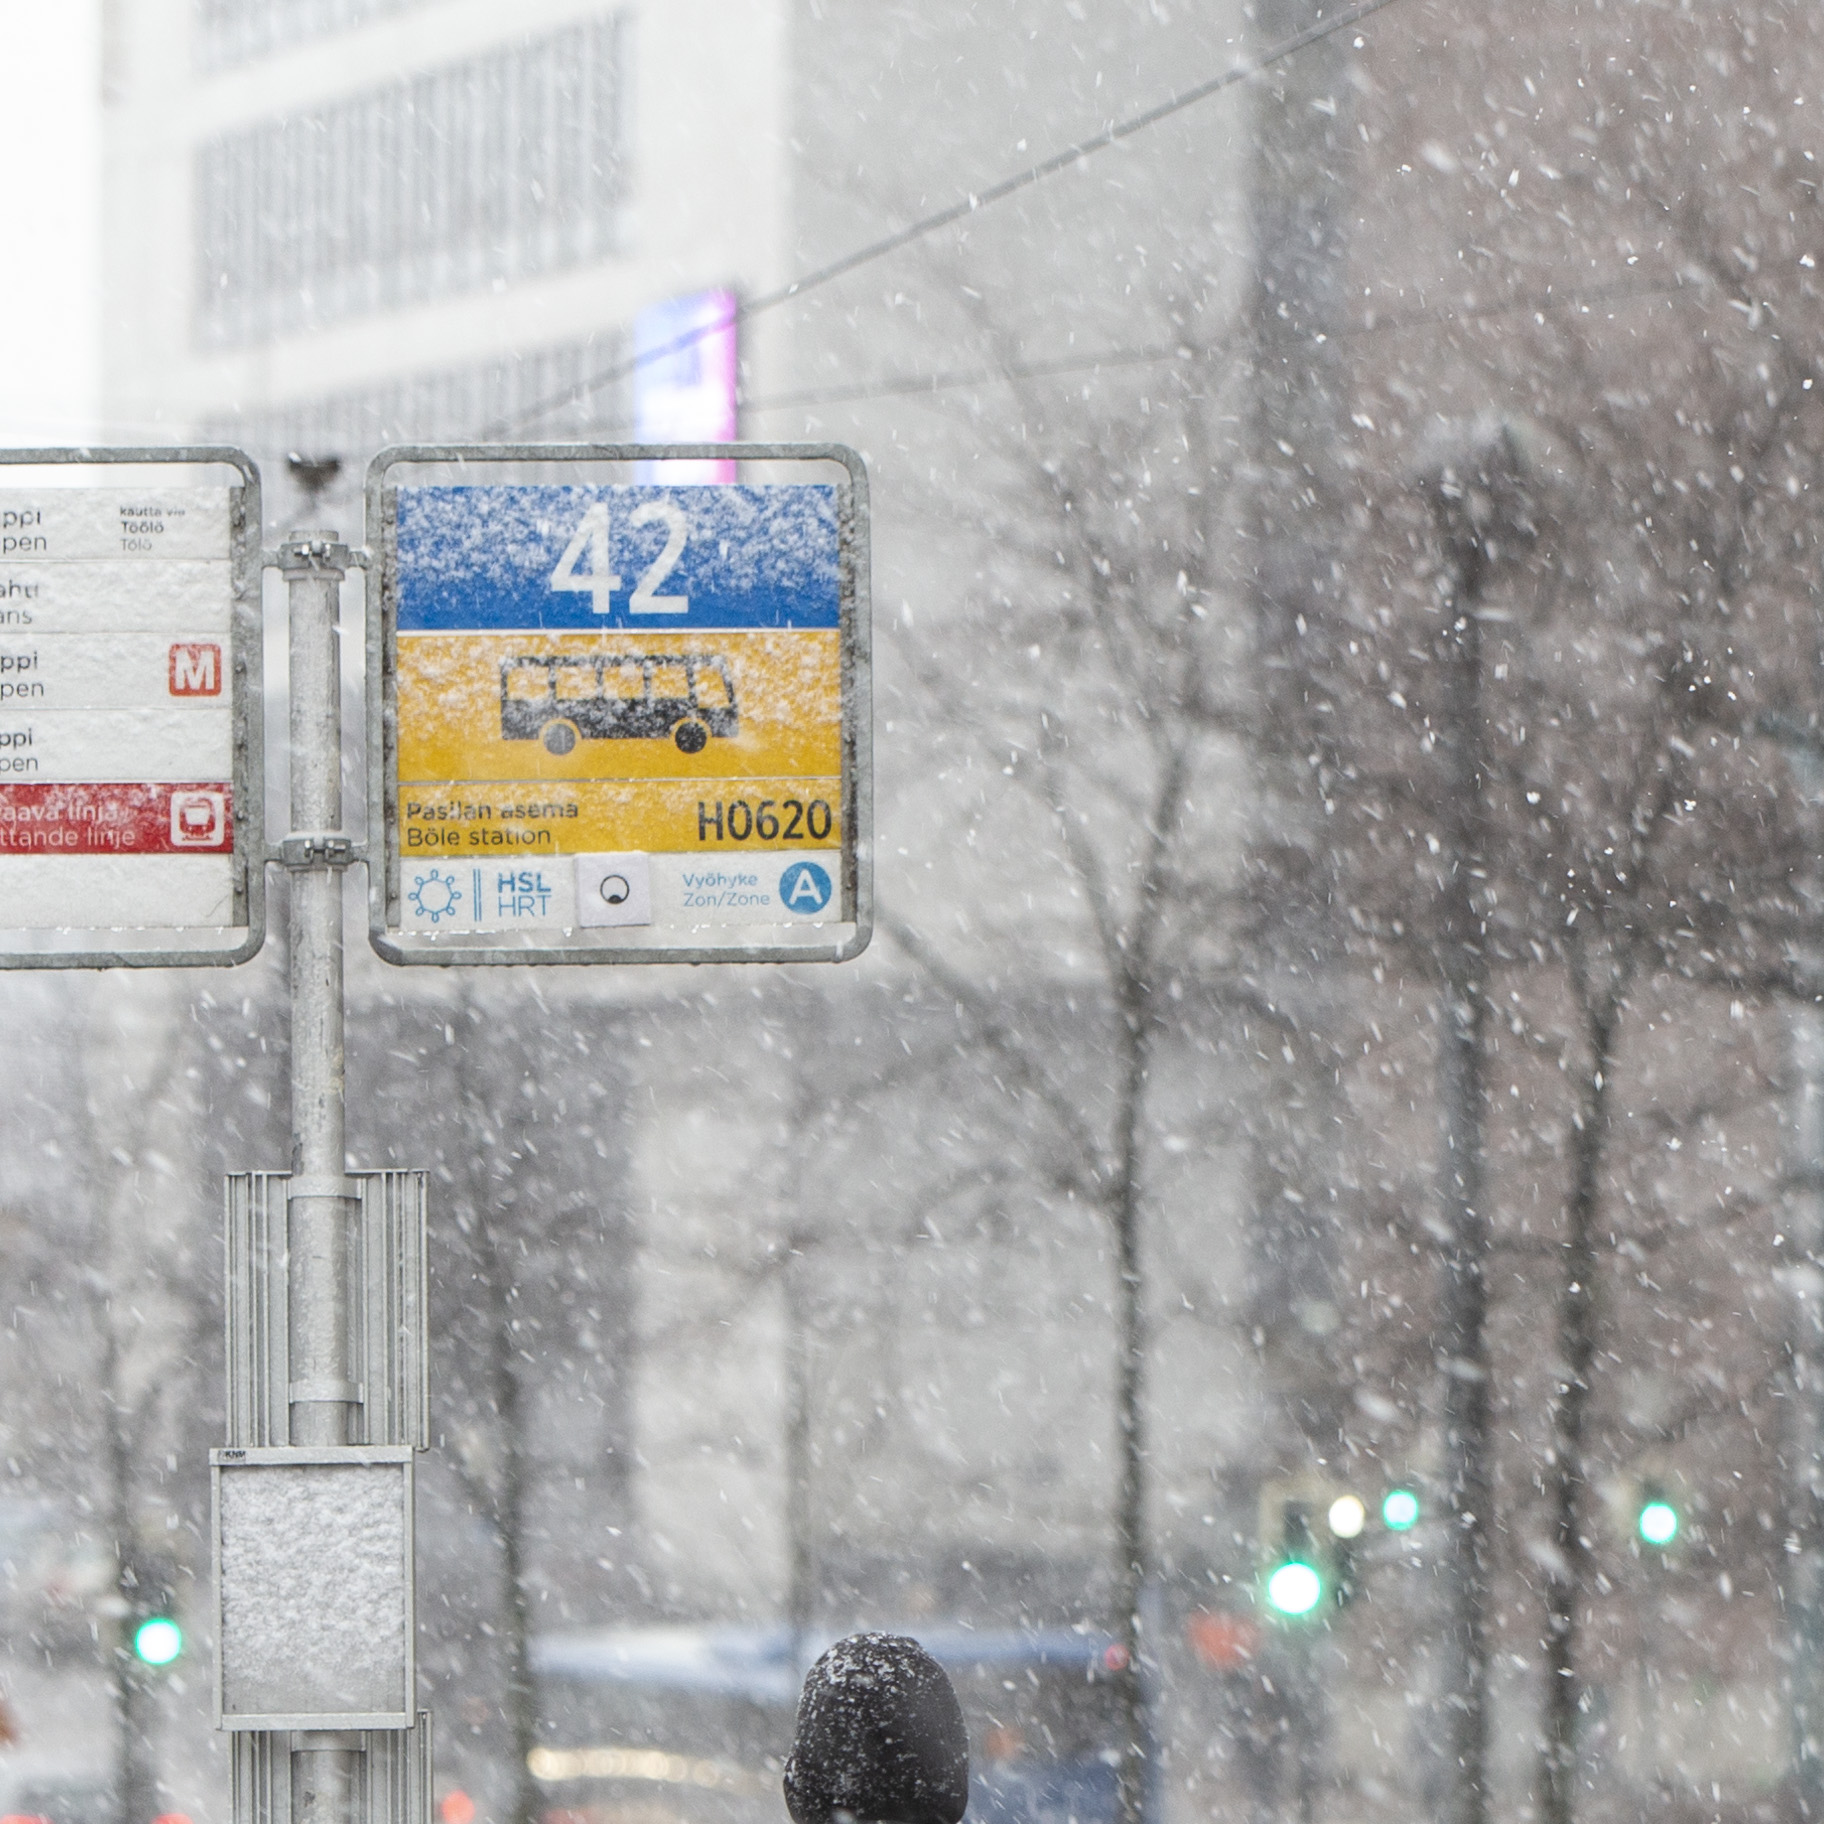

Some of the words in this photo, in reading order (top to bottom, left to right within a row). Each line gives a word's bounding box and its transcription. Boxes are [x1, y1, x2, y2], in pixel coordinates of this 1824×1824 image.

[120, 506, 162, 517] kautta
[121, 520, 164, 534] Töölö
[120, 538, 153, 552] Tölö
[551, 501, 690, 614] 42
[68, 801, 119, 825] linja
[407, 801, 491, 820] Pasilan
[500, 803, 579, 819] asema
[698, 800, 832, 841] H0620
[87, 826, 136, 849] linje
[407, 827, 460, 847] Böle
[469, 826, 551, 846] station
[497, 872, 552, 894] HSL
[682, 872, 758, 889] Vyöhyke
[788, 867, 824, 906] A
[498, 894, 552, 917] HRT
[683, 892, 771, 908] Zon/Zone
